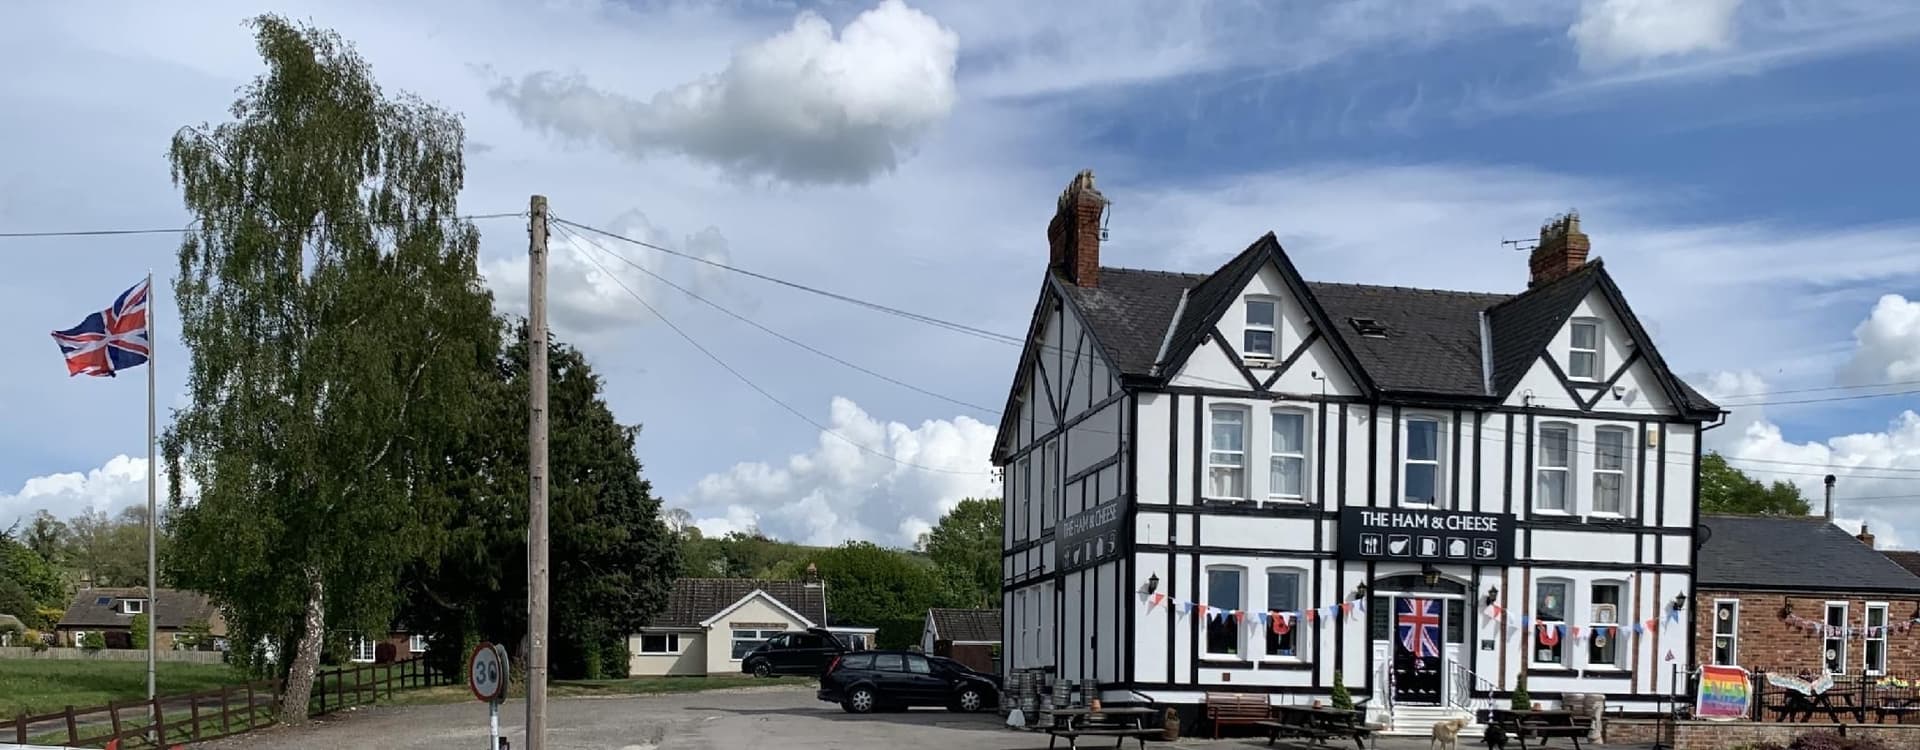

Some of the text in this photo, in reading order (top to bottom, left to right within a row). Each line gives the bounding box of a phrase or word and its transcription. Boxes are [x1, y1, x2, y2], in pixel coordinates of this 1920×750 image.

[1063, 520, 1074, 538] THE
[1074, 514, 1089, 535] HAM
[1095, 503, 1118, 527] CHEESE
[1361, 511, 1498, 532] THE HAM & CHEESE
[476, 660, 498, 685] 30
